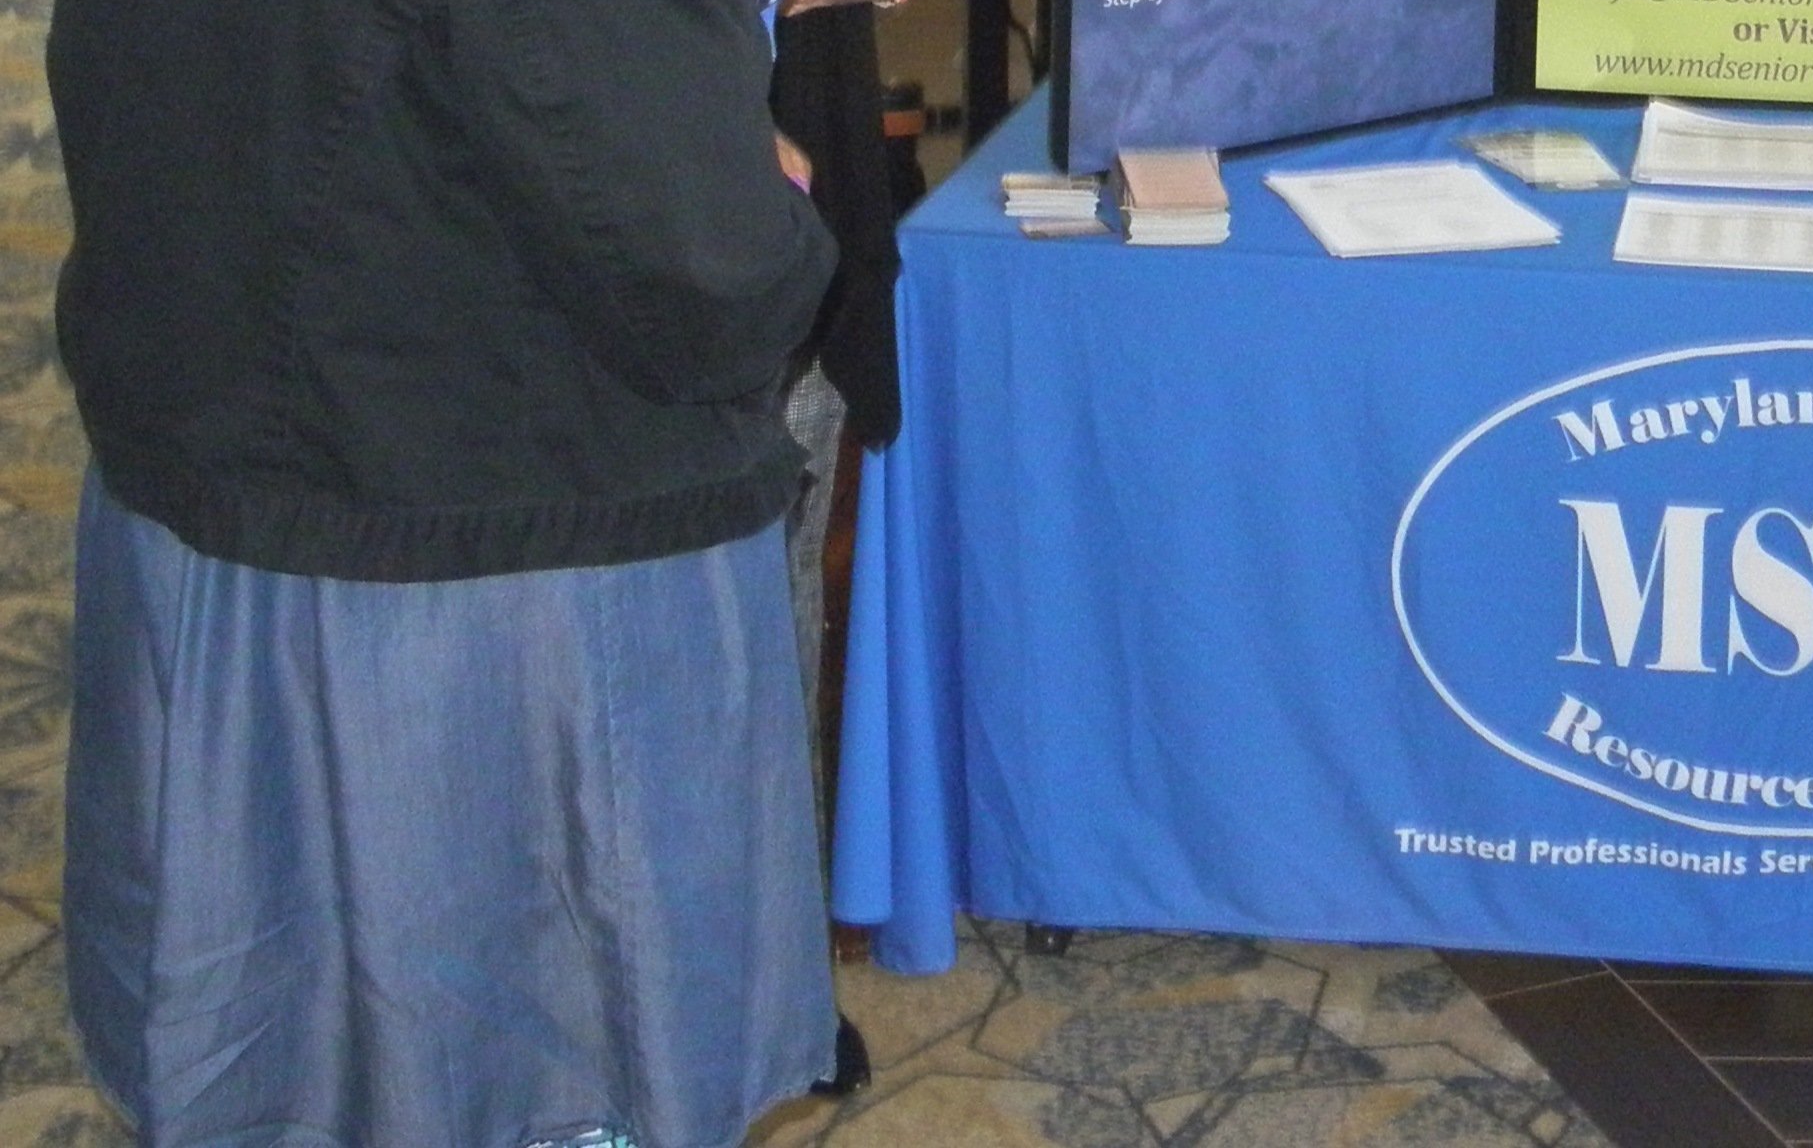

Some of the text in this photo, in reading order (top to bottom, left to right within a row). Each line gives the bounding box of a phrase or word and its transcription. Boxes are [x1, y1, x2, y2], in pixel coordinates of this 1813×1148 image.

[1733, 20, 1770, 43] or
[1394, 827, 1518, 862] Trusted
[1529, 837, 1749, 876] Professionals
